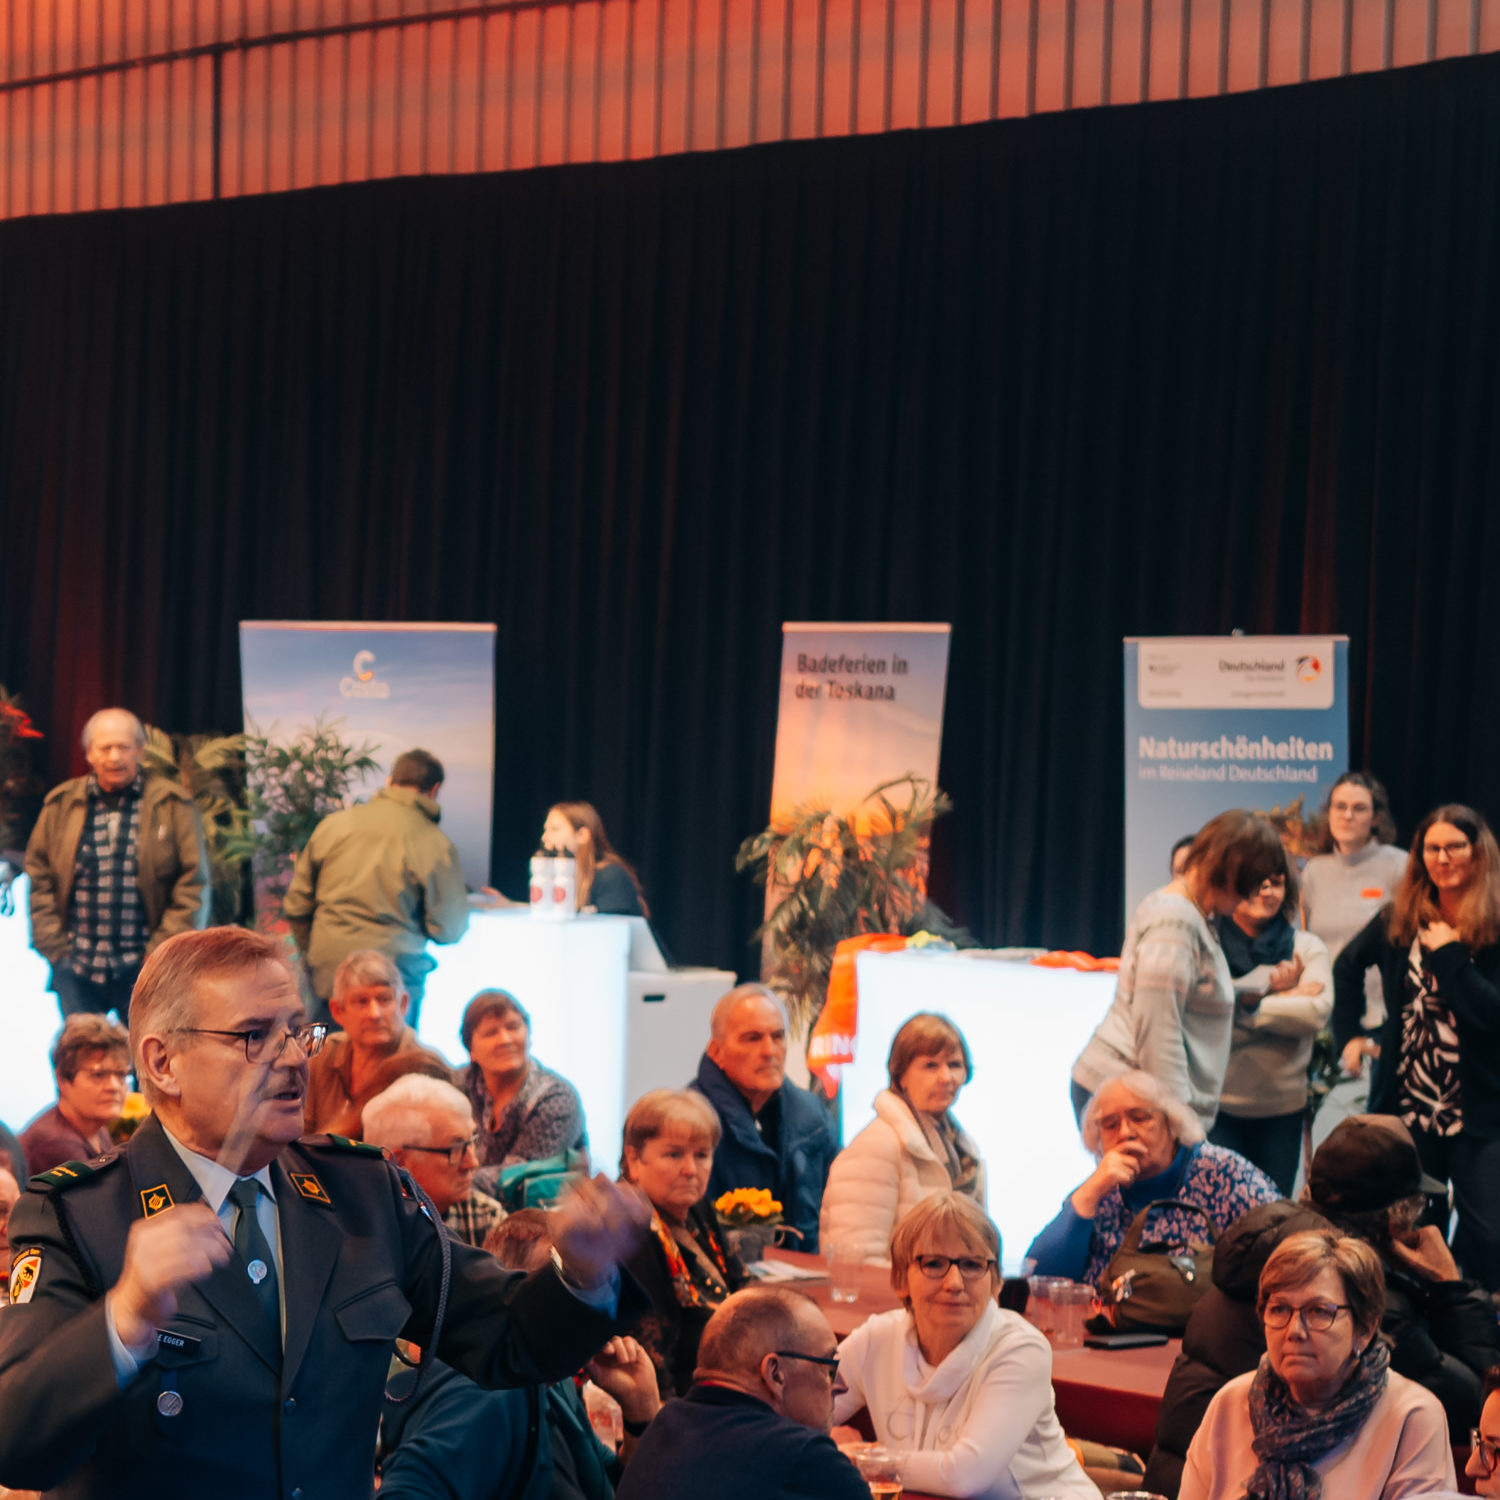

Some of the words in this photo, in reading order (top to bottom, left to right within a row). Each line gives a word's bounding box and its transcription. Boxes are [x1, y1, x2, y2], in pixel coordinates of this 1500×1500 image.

[797, 653, 887, 674] Badeferien
[892, 653, 908, 674] in
[1218, 659, 1285, 673] Deutschland
[795, 680, 819, 699] der
[827, 680, 896, 701] Toskana
[1138, 734, 1334, 760] Naturschönheiten
[1138, 765, 1156, 778] im
[1159, 765, 1225, 781] Reiseland
[1229, 765, 1318, 783] Deutschland
[163, 1335, 185, 1347] EGGER
